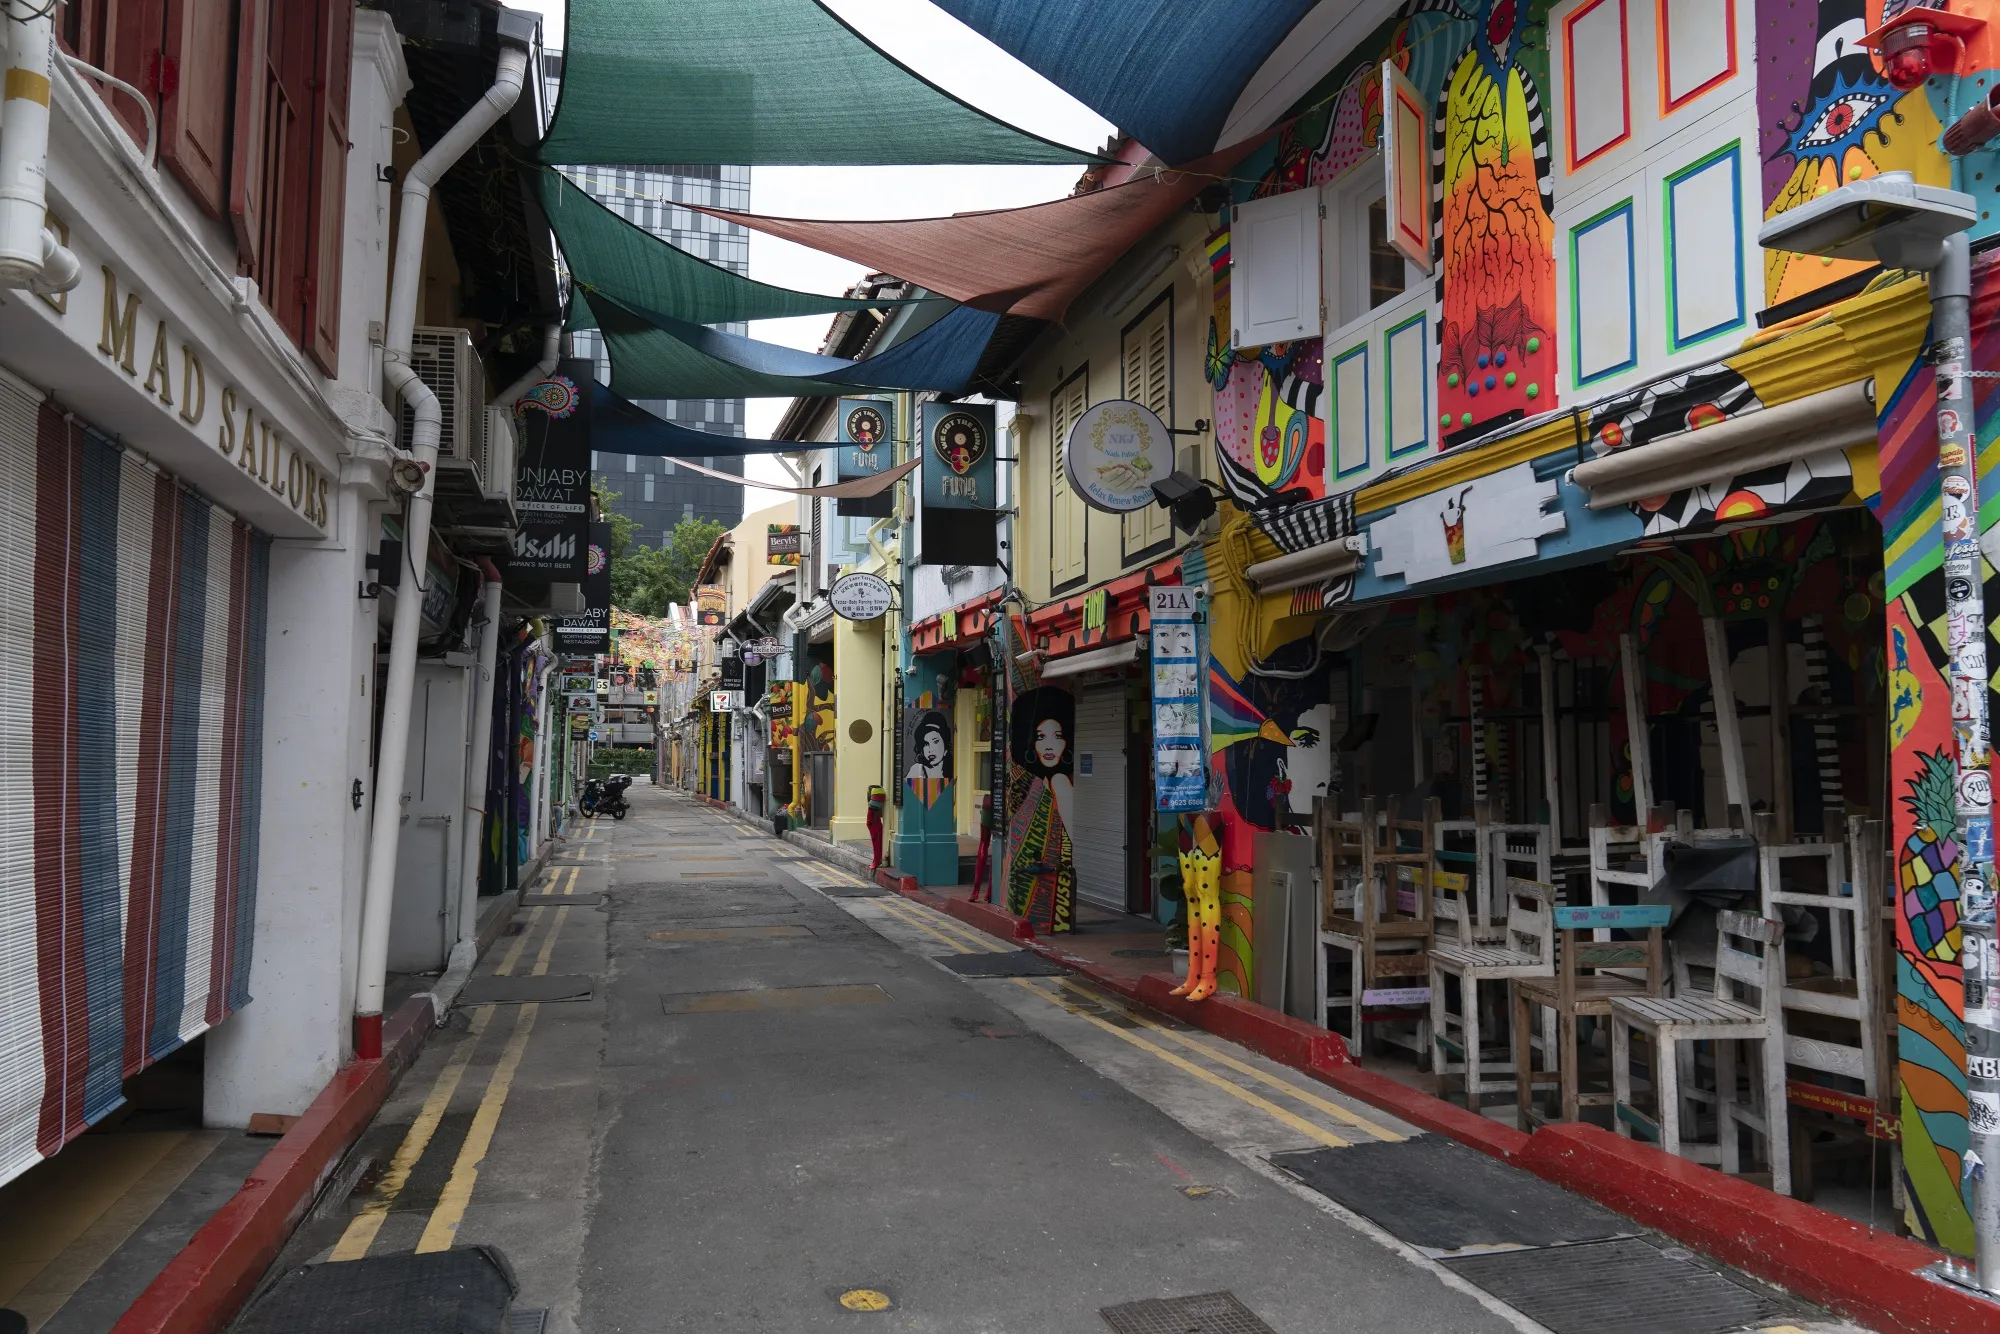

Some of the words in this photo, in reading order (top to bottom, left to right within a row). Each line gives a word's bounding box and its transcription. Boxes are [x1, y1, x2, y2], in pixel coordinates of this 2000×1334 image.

[97, 264, 206, 425] MAD
[219, 387, 329, 528] SAILORS
[941, 420, 955, 435] GOT
[956, 418, 973, 428] THE
[940, 435, 949, 450] WE
[971, 425, 980, 451] FUNK
[1108, 433, 1136, 445] NKJ
[1104, 450, 1120, 458] Nails
[516, 466, 587, 486] UNJABY
[1088, 482, 1107, 501] Relax
[1107, 494, 1132, 505] Renew
[1132, 487, 1153, 504] Revita
[515, 531, 577, 560] Asahi
[770, 536, 797, 547] Beryl's
[1157, 592, 1190, 609] 21A
[563, 619, 601, 628] DAWAT
